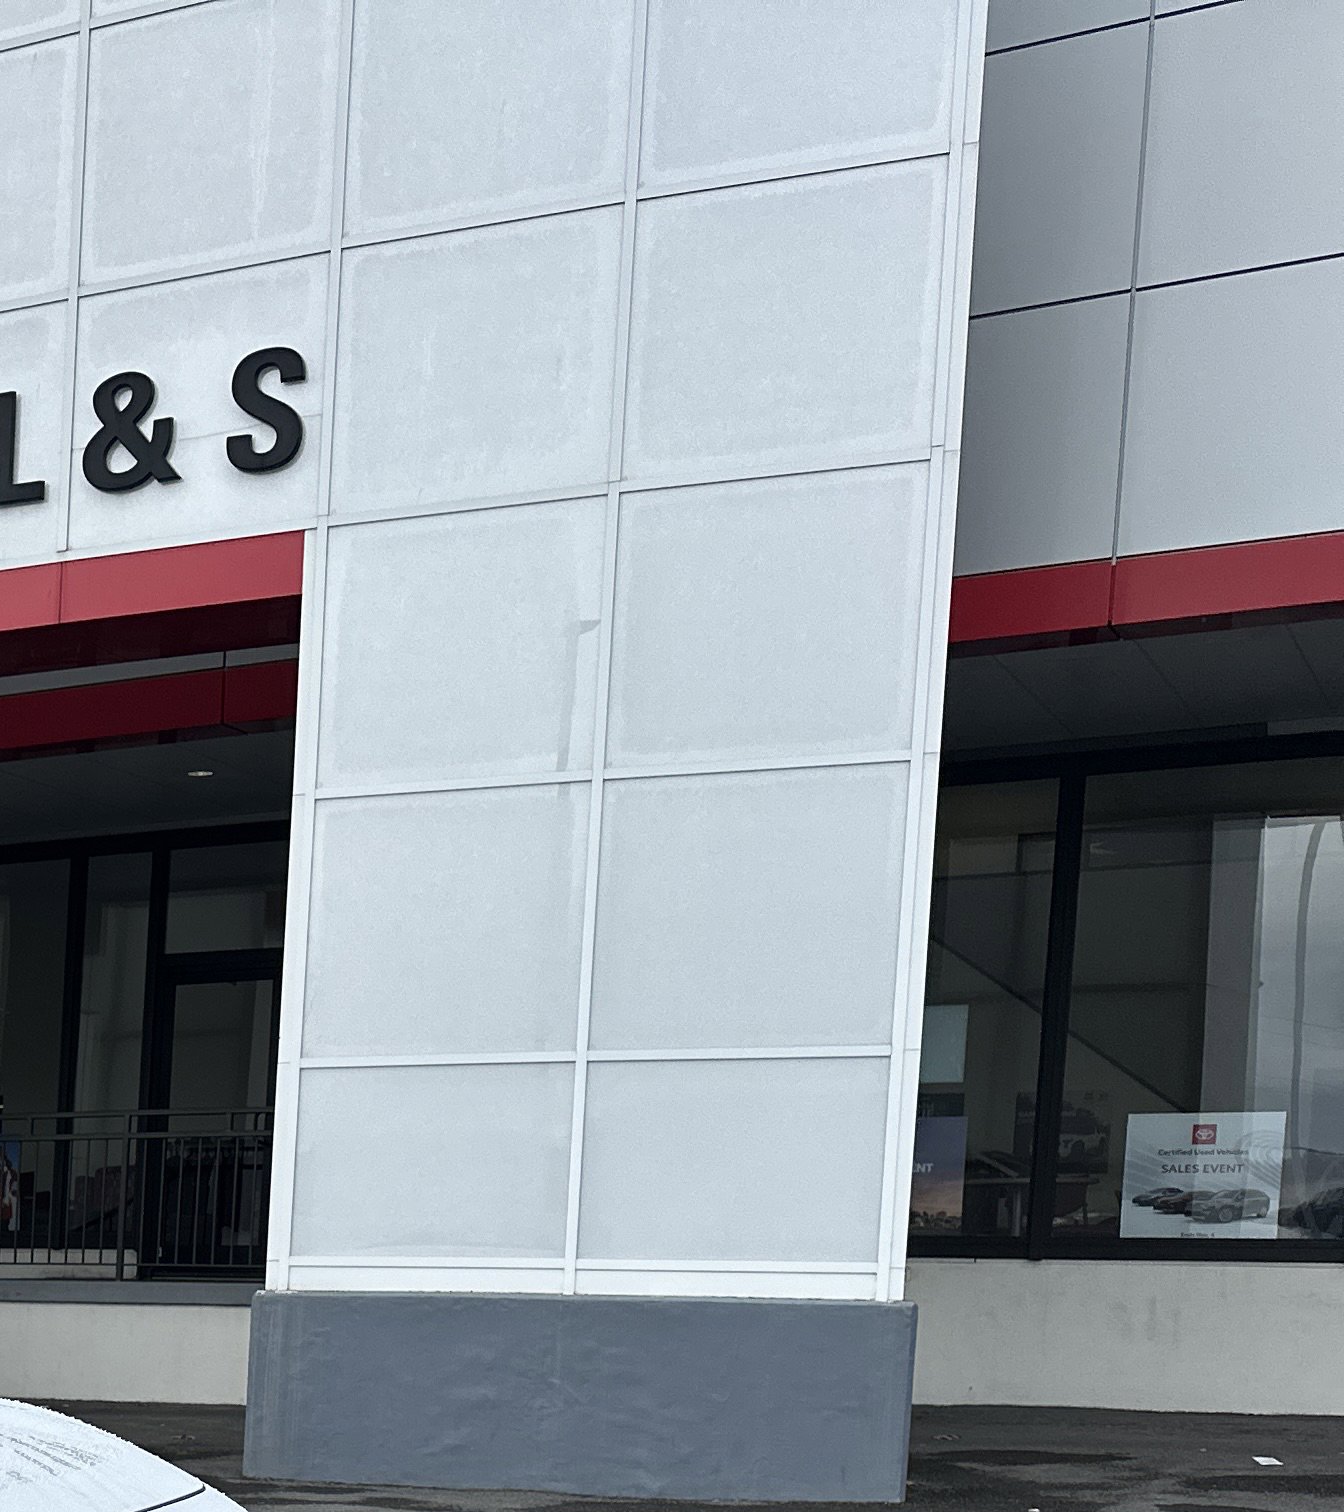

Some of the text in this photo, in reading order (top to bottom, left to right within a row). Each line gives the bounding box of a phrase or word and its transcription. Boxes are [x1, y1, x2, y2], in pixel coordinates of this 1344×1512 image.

[82, 371, 182, 493] &
[226, 346, 306, 474] S
[1158, 1148, 1192, 1156] Certified
[1161, 1164, 1245, 1174] SALES EVENT
